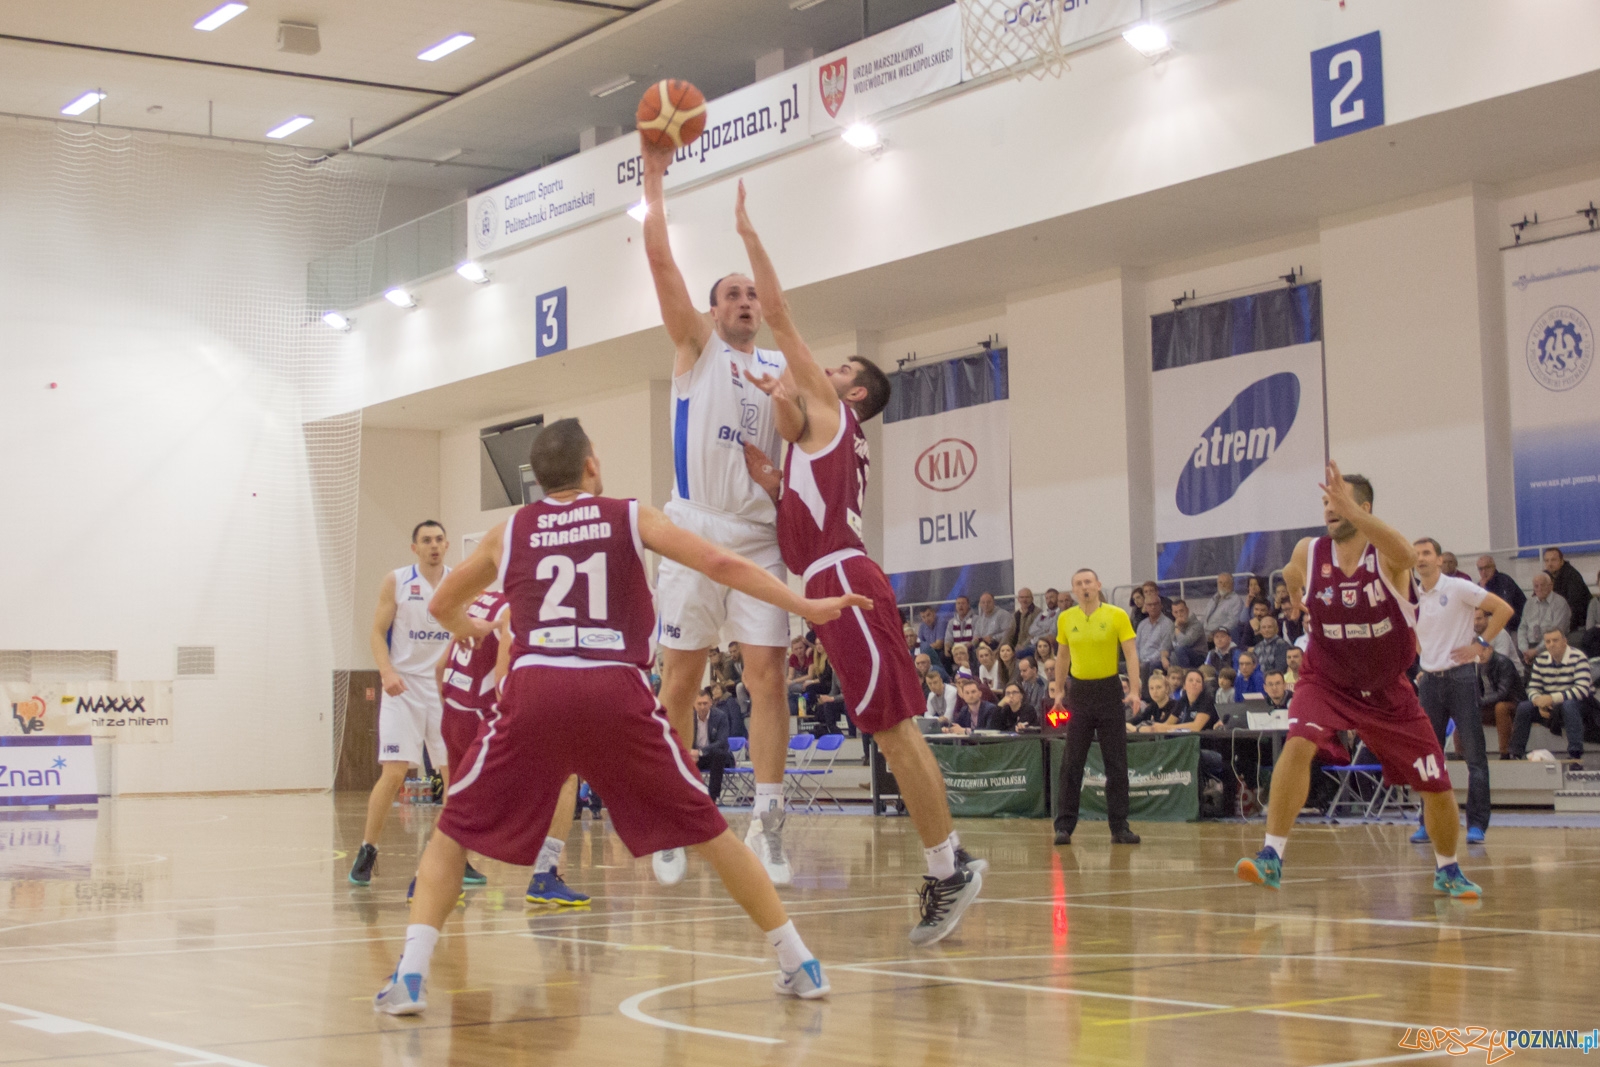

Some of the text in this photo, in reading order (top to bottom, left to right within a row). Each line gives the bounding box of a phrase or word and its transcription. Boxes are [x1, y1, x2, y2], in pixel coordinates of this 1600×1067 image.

[1329, 49, 1365, 128] 2
[504, 178, 564, 211] Centrum Sportu
[505, 204, 547, 235] Politechniki
[549, 188, 596, 220] Poznańskiej
[542, 296, 558, 348] 3
[1194, 426, 1277, 469] atrem
[928, 449, 967, 482] KIA
[529, 522, 611, 549] STARGARD
[919, 509, 978, 545] DELIK
[536, 552, 608, 622] 21
[1363, 579, 1387, 607] 14
[409, 630, 452, 641] BIOFAR
[76, 695, 147, 714] MAXXX
[107, 719, 126, 727] za
[128, 717, 169, 727] hitem
[1413, 753, 1441, 782] 14
